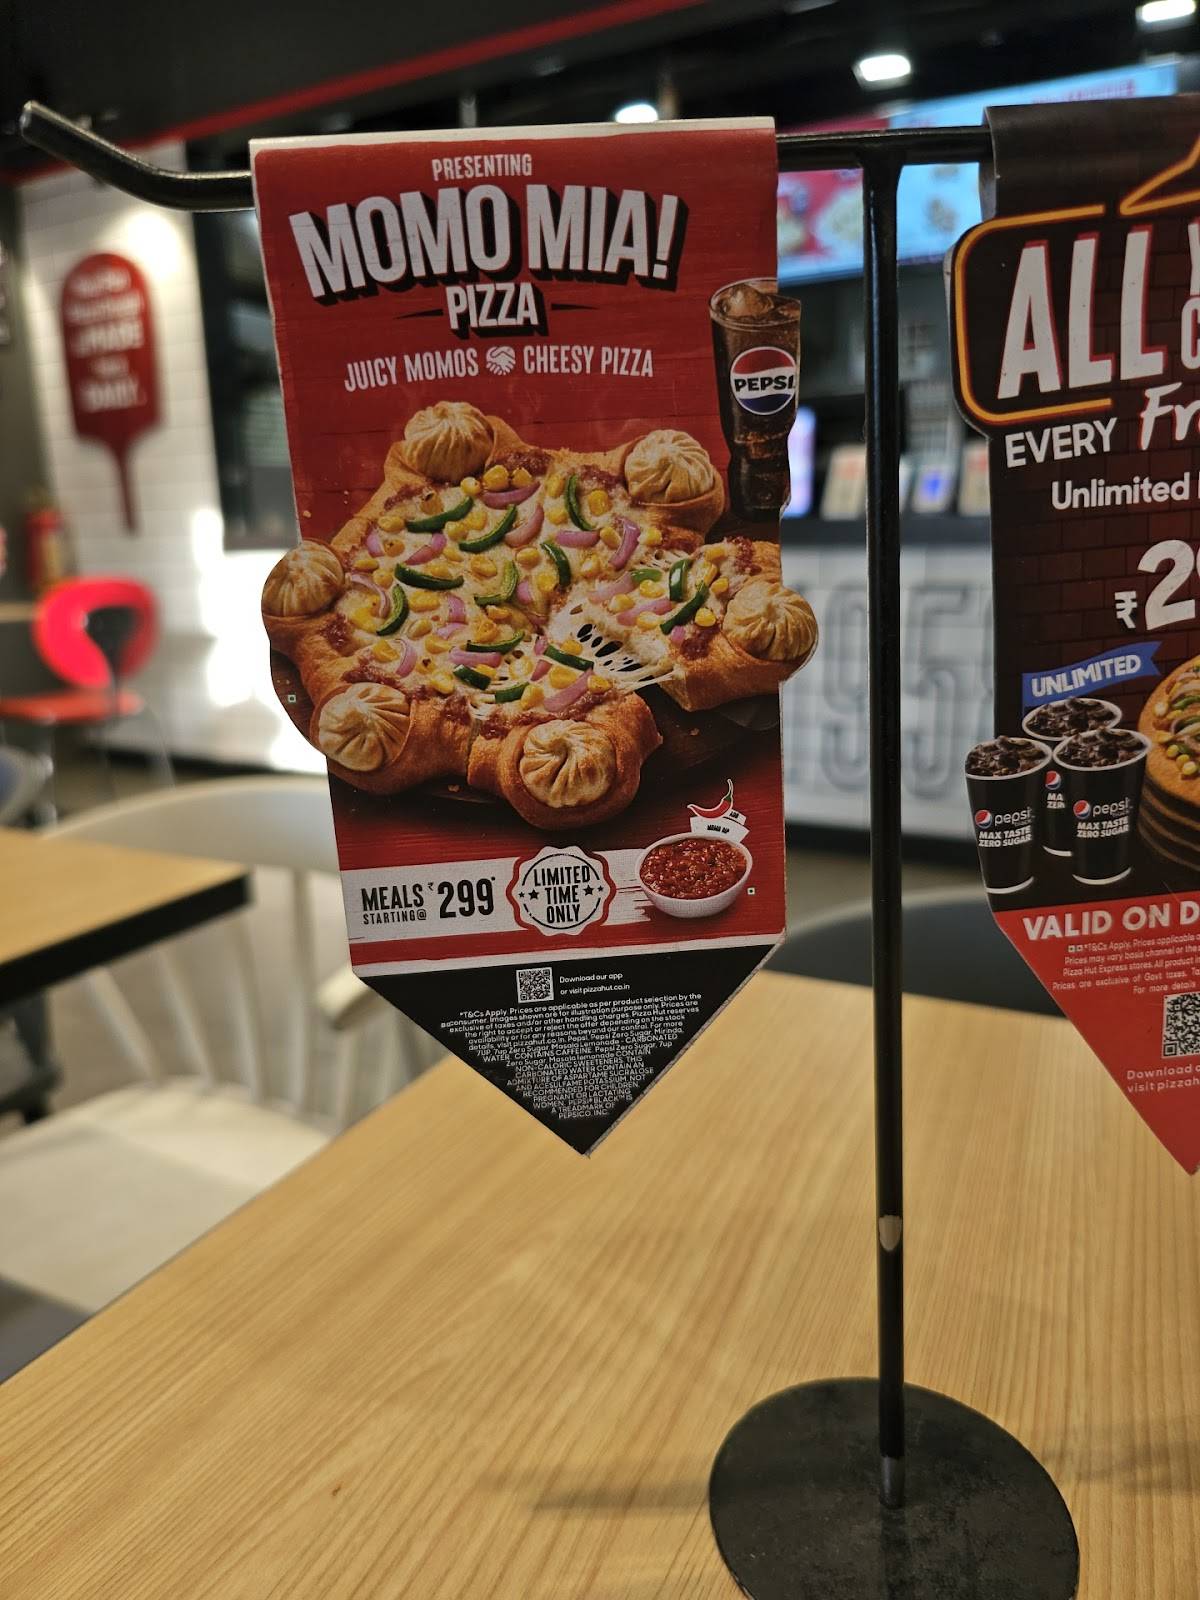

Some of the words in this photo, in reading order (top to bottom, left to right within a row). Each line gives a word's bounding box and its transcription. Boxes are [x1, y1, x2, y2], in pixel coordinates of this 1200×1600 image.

[432, 154, 532, 181] PRESENTING
[289, 184, 516, 300] MOMO
[526, 184, 681, 282] MIA!
[446, 282, 540, 331] PIZZA
[997, 226, 1165, 400] ALL
[344, 358, 398, 392] JUICY
[403, 348, 479, 382] MOMOS
[523, 346, 594, 375] CHEESY
[601, 346, 653, 378] PIZZA
[734, 375, 794, 392] PEPSI
[1005, 417, 1118, 469] EVERY
[1051, 472, 1190, 512] Unlimited
[1031, 655, 1142, 697] UNLIMITED
[995, 807, 1031, 827] pepsi
[1093, 797, 1129, 817] pepsi
[979, 831, 1001, 841] MAX
[1003, 825, 1031, 838] TASTE
[1077, 822, 1100, 831] MAX
[1101, 816, 1129, 829] TASTE
[1077, 830, 1099, 838] ZERO
[1101, 825, 1129, 838] SUGAR
[978, 839, 1001, 849] ZERO
[1003, 834, 1032, 847] SUGAR
[533, 865, 591, 886] LIMITED
[361, 883, 424, 911] MEALS
[545, 884, 580, 904] TIME
[363, 908, 427, 925] STARTING@
[546, 903, 581, 924] ONLY
[1022, 909, 1113, 941] VALID
[1121, 903, 1170, 931] ON
[1064, 955, 1088, 965] Prices
[1100, 963, 1128, 974] Express
[560, 974, 595, 983] Download
[1052, 981, 1076, 990] Prices
[583, 984, 630, 995] pizzahut.co.in
[490, 1014, 518, 1024] Images
[520, 1012, 543, 1020] shown
[570, 1006, 610, 1016] illustration
[612, 1005, 642, 1014] purpose
[661, 1000, 684, 1008] Prices
[510, 1007, 533, 1015] Prices
[548, 1002, 587, 1013] applicable
[612, 998, 642, 1008] product
[644, 995, 677, 1004] selection
[450, 1023, 484, 1032] exclusive
[494, 1021, 515, 1029] taxes
[543, 1017, 563, 1025] other
[564, 1014, 598, 1025] handling
[667, 1007, 700, 1015] reserves
[478, 1029, 496, 1038] right
[600, 1017, 640, 1028] depending
[626, 1033, 678, 1043] CARBONATED
[1127, 1064, 1192, 1080] Download
[1127, 1081, 1154, 1094] visit
